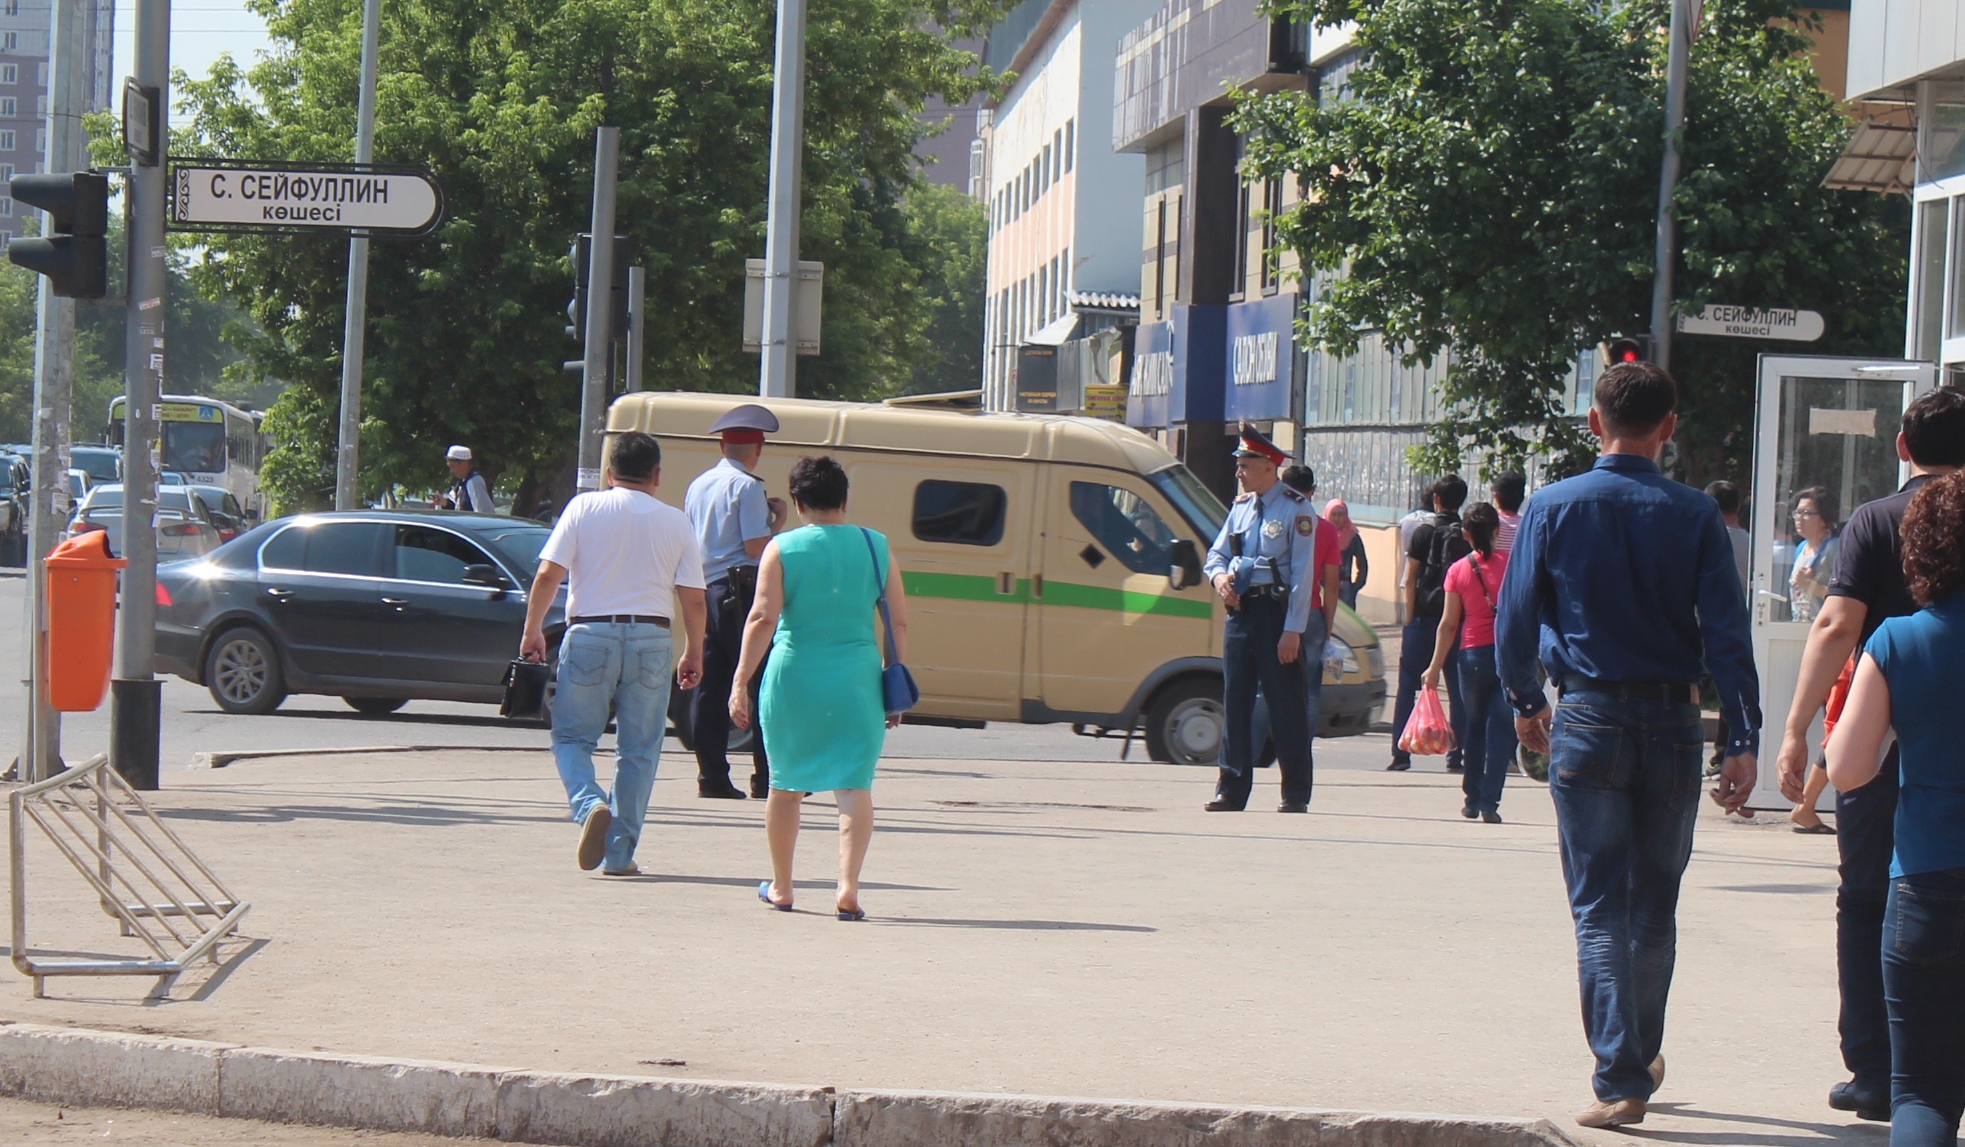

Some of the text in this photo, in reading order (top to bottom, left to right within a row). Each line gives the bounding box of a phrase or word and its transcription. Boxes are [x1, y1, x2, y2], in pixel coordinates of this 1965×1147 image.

[210, 173, 388, 204] С. СЕЙФУЛЛИН
[262, 204, 341, 222] көшесі
[1713, 306, 1796, 327] СЕЙФУЛЛИН
[1725, 325, 1770, 336] көшесі
